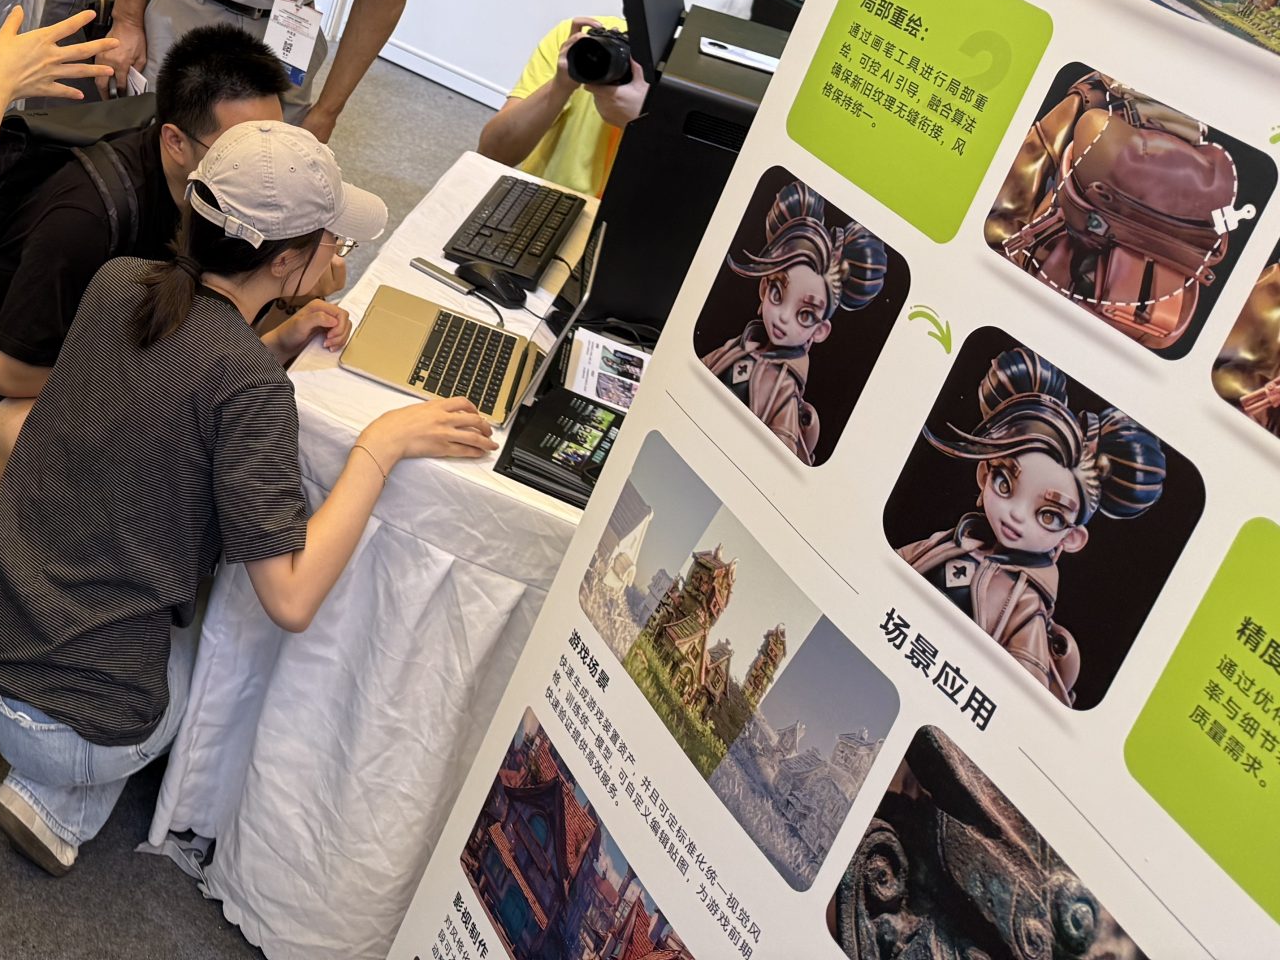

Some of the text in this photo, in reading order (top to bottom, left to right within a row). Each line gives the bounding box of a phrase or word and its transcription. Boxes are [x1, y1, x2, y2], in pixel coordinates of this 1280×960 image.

[822, 81, 876, 128] 格保持统一。
[830, 61, 966, 156] 确保新旧纹理无缝衔接，风
[838, 41, 977, 134] 绘，可控 AI 引导，融合算法
[848, 22, 988, 112] 通过画笔工具进行局部重
[568, 628, 611, 693] 游戏场景
[879, 607, 997, 731] 场景应用
[1236, 616, 1280, 676] 精度
[544, 684, 619, 807] 快速验证提供高效服务。
[1188, 704, 1267, 788] 质量需求。
[1203, 679, 1280, 765] 率与细节
[453, 891, 488, 959] 影视制作
